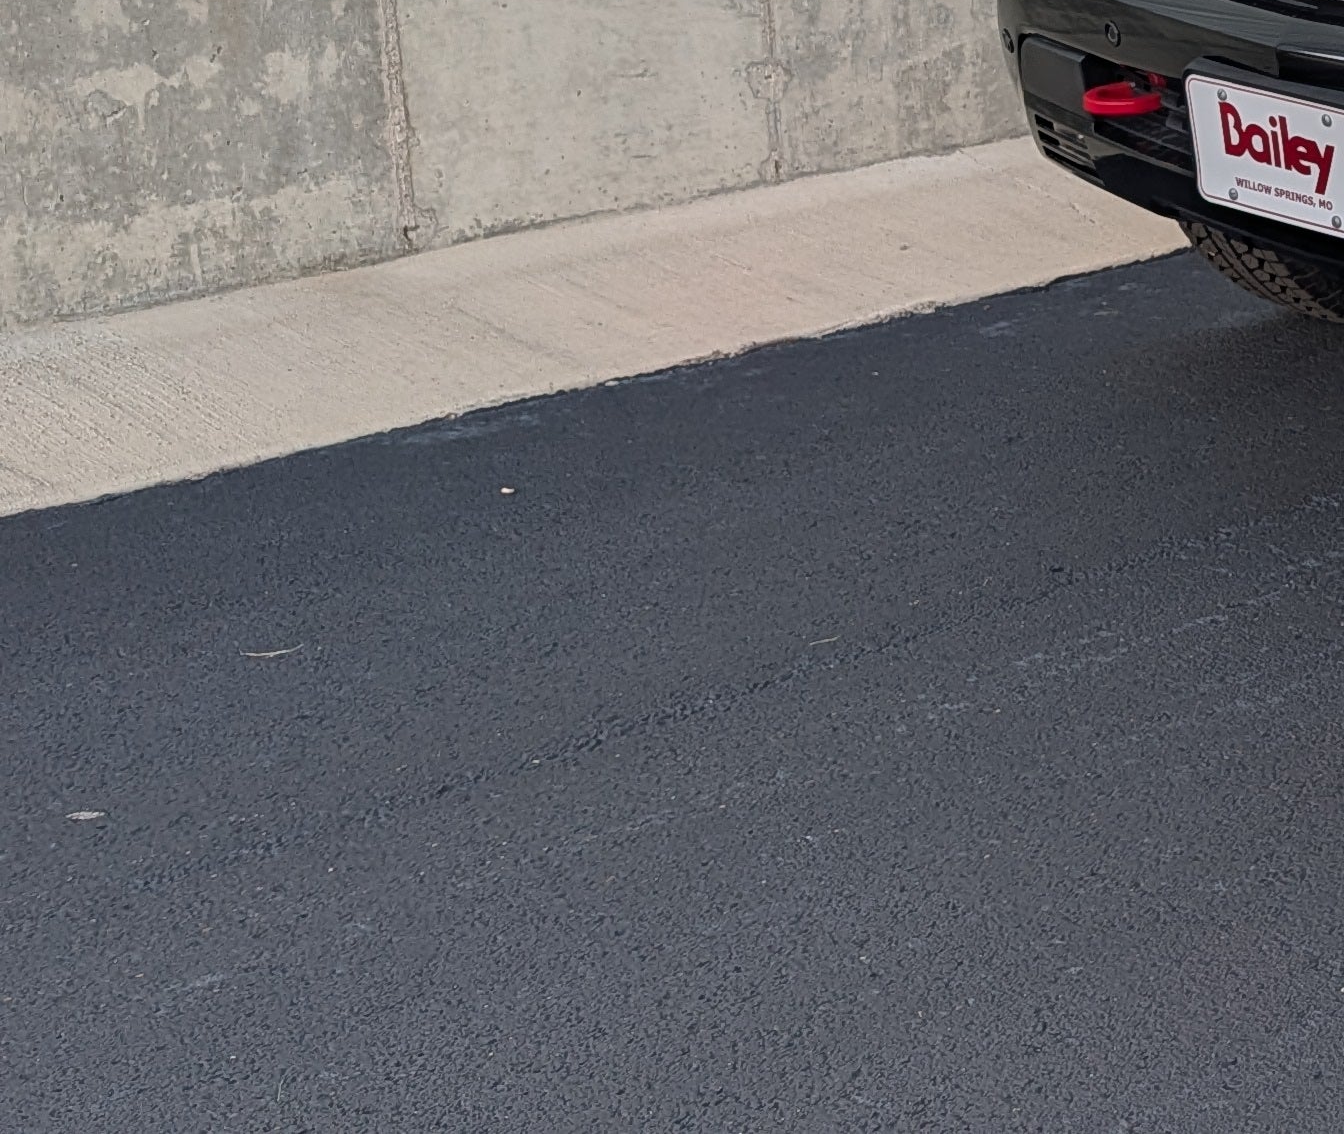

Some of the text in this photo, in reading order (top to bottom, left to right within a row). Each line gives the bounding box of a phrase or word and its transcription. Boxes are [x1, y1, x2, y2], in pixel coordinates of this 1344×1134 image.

[1218, 100, 1335, 195] Bailey
[1235, 177, 1333, 211] WILLOW SPRINGS, MO
